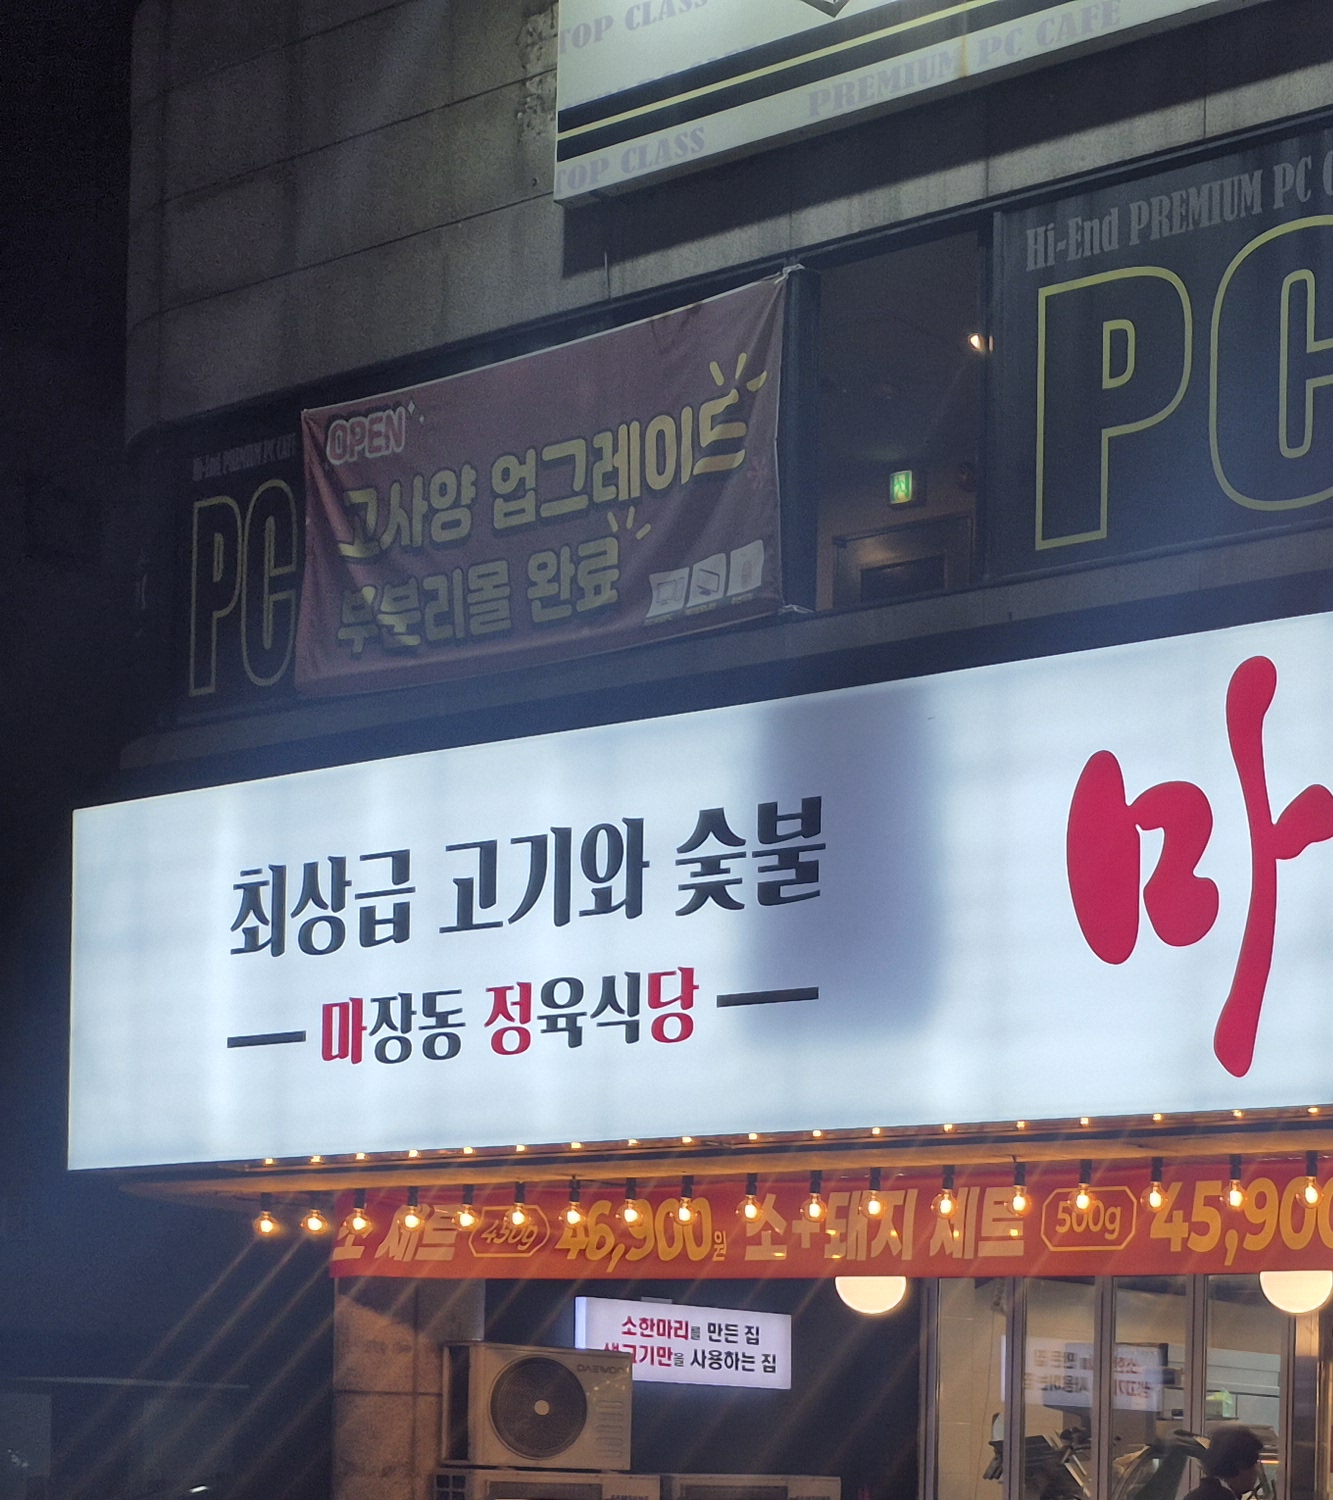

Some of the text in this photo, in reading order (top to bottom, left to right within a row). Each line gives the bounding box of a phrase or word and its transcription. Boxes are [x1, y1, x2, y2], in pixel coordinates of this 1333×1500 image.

[621, 126, 705, 174] CLASS
[807, 42, 965, 118] PREMIUM
[977, 28, 1023, 67] PC
[1037, 1, 1121, 48] CAFE
[1026, 207, 1120, 272] Hi-End
[1128, 167, 1264, 251] PREMIUM
[1272, 156, 1313, 209] PC
[326, 406, 406, 465] OPEN
[338, 388, 748, 559] 고사양 업그레이드
[189, 479, 298, 697] PC
[527, 536, 620, 624] 완료
[229, 795, 827, 957] 최상급 고기와 숯불
[321, 966, 699, 1065] 마장동 정육식당
[929, 1184, 1026, 1260] 세트
[621, 1315, 760, 1346] 소한마리를 만든 집
[690, 1348, 756, 1373] 사용하는
[761, 1353, 777, 1374] 집
